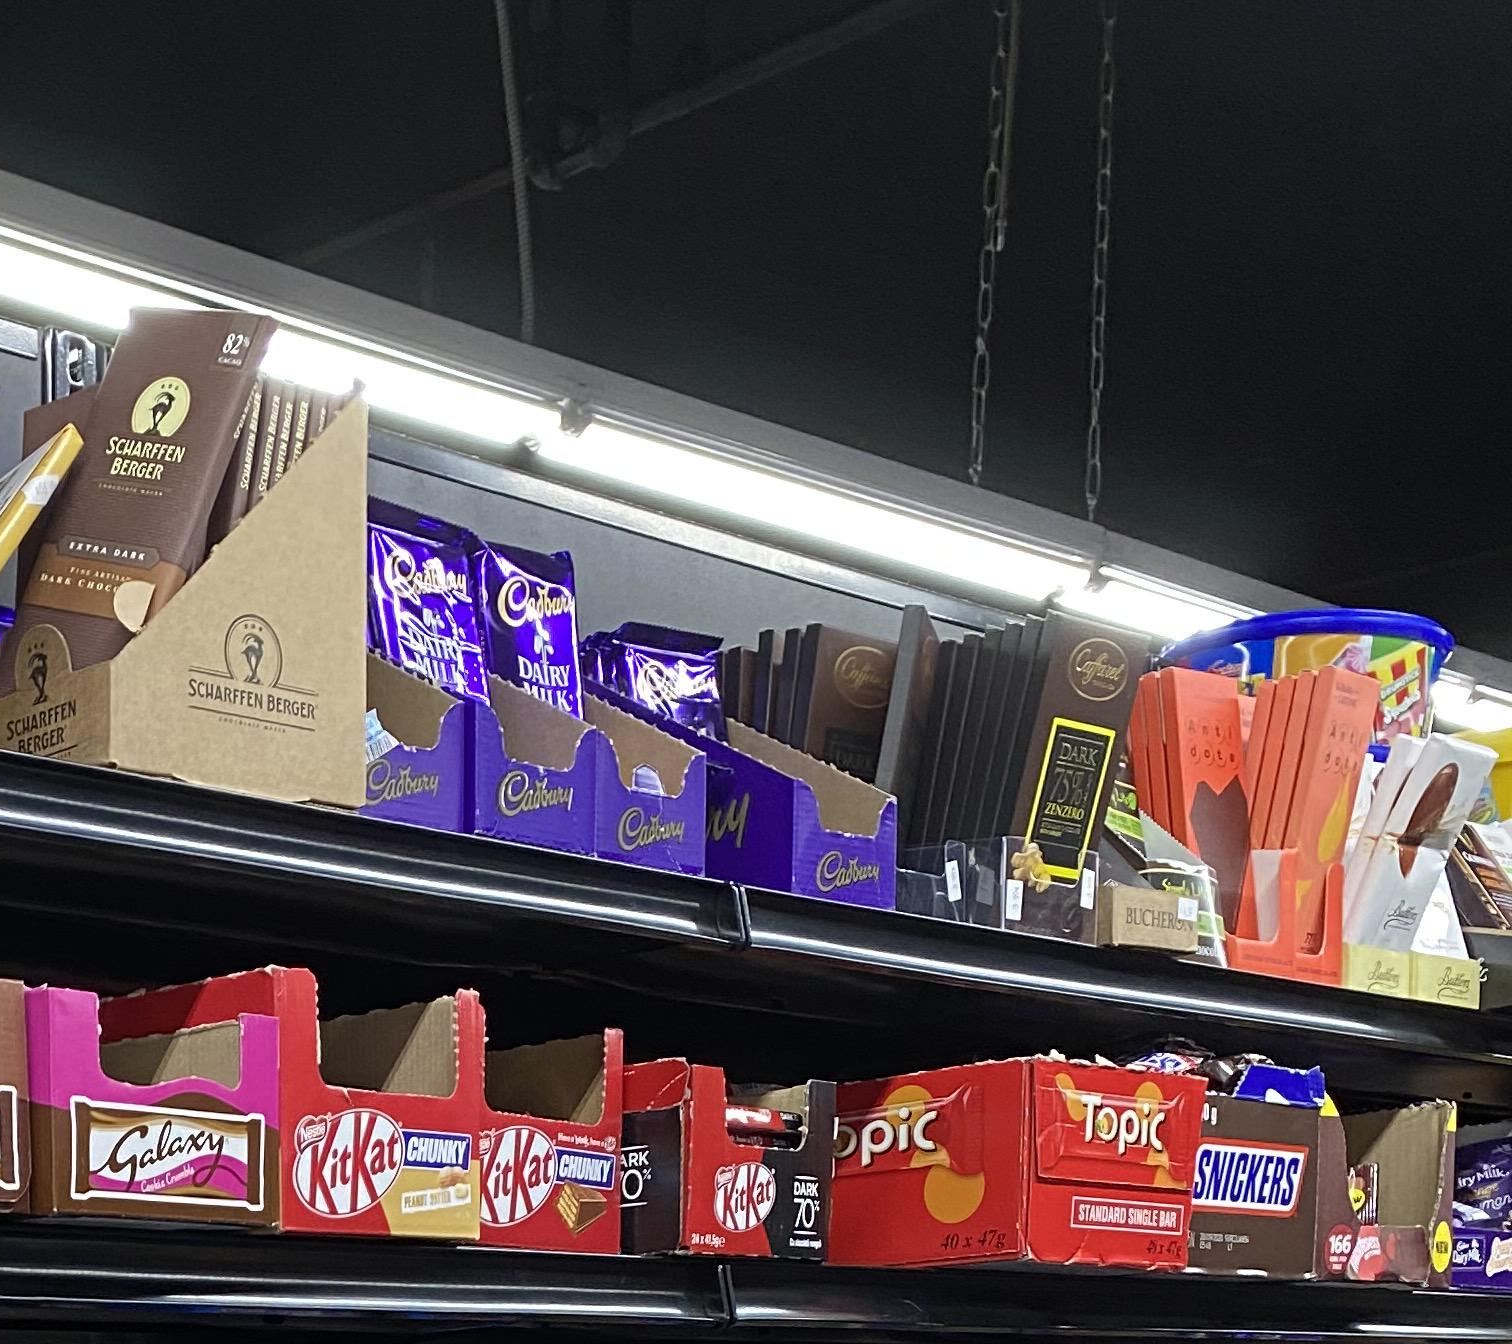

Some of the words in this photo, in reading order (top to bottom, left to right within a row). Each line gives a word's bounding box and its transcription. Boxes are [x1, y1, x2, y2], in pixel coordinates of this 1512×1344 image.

[106, 436, 186, 463] SCHARFFEN
[110, 458, 164, 481] BERGER
[69, 541, 109, 557] EXTRA
[113, 548, 147, 561] DARK
[517, 656, 571, 689] DAIRY
[188, 678, 264, 711] SCHARFFEN
[267, 692, 318, 720] BERGER
[1058, 741, 1099, 767] DARK
[817, 851, 880, 893] Cadbury
[833, 1103, 938, 1167] opic
[1081, 1093, 1166, 1156] Topic
[407, 1133, 467, 1166] CHUNKY
[558, 1153, 611, 1185] CHUNKY
[1194, 1149, 1300, 1207] SNICKERS
[793, 1180, 819, 1197] DARK
[1078, 1205, 1126, 1226] STANDARD
[1128, 1208, 1157, 1228] SINGLE
[1159, 1211, 1177, 1229] BAR
